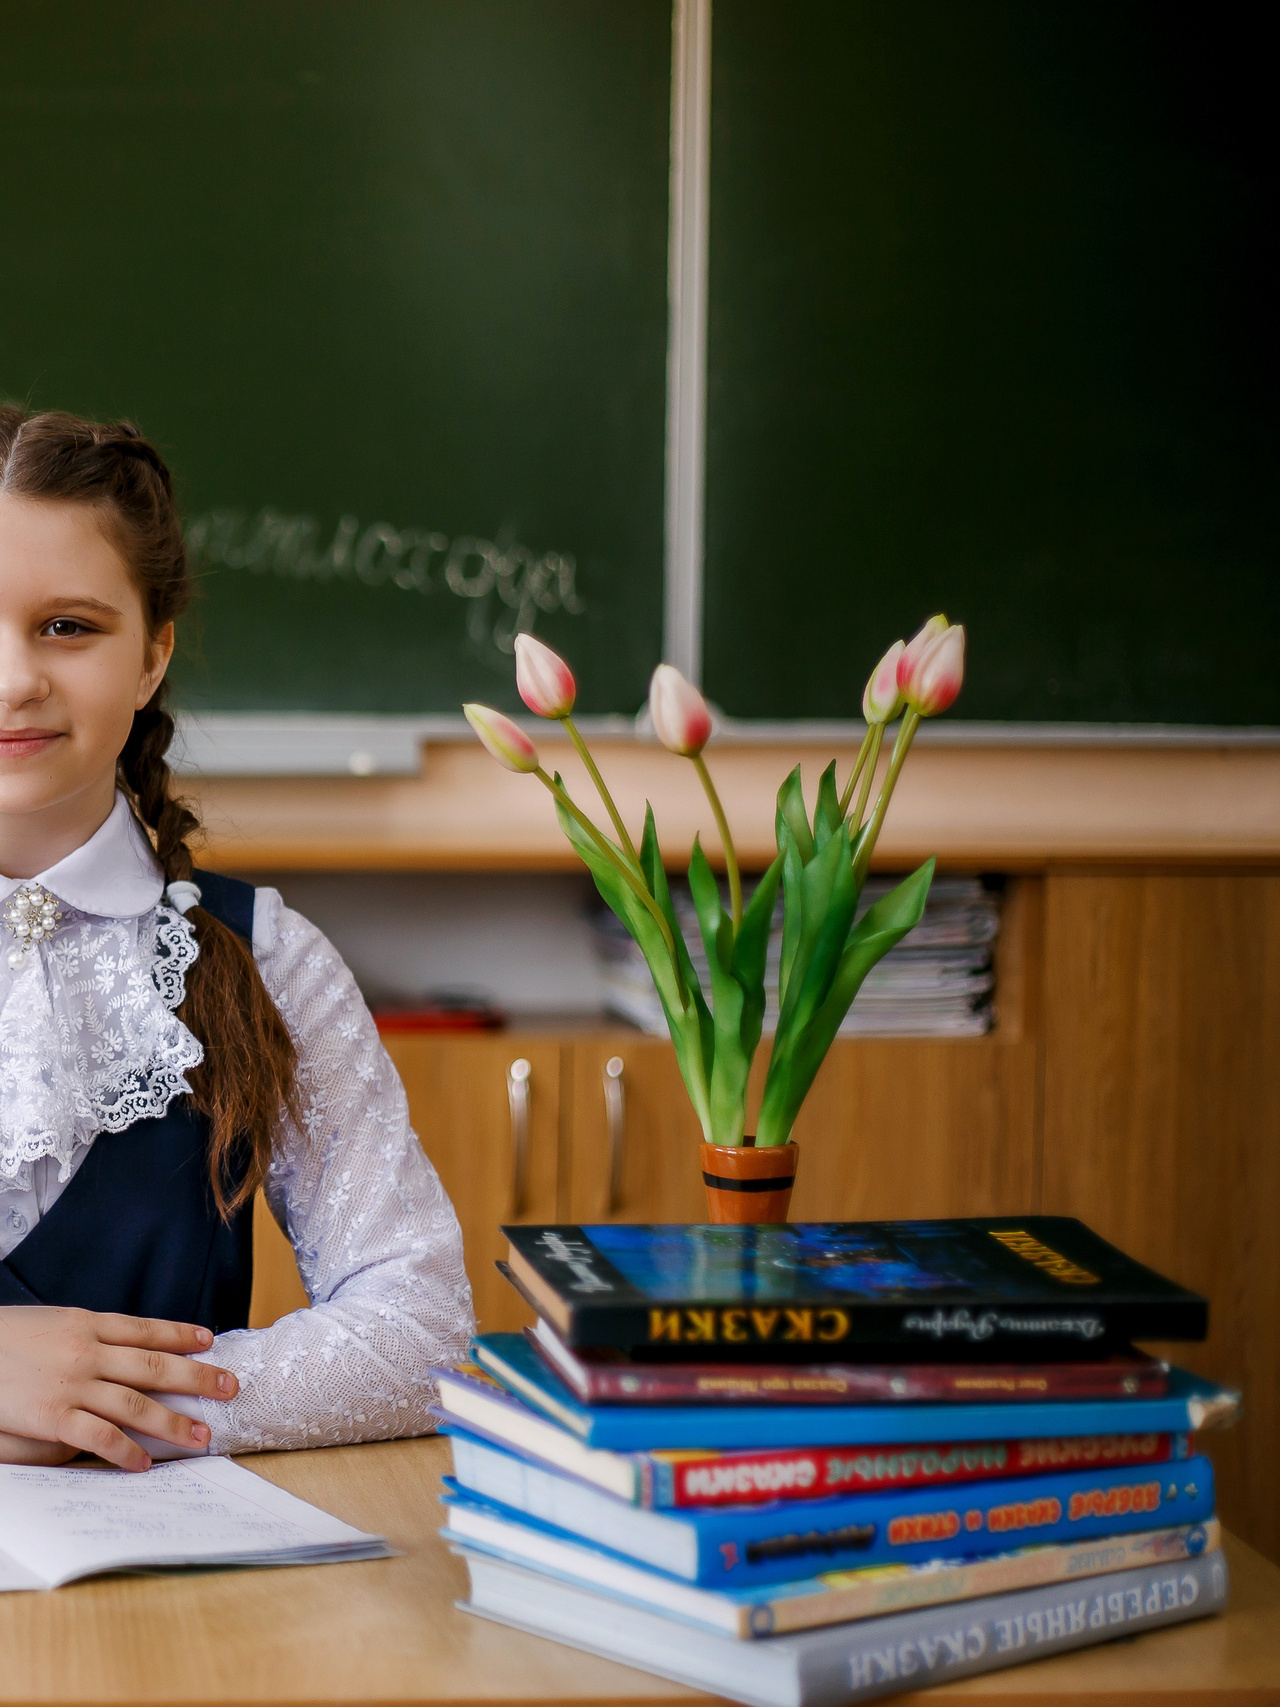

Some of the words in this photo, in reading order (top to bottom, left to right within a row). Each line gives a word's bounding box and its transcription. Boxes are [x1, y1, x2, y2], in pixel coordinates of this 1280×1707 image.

[648, 1307, 851, 1342] СКАЗКИ
[826, 1442, 1009, 1485] НАРОДНЫЕ
[1020, 1433, 1159, 1467] РУССКИЕ
[684, 1458, 817, 1498] СКАЗКИ
[987, 1497, 1062, 1533] СКАЗКИ
[1068, 1481, 1162, 1521] ДОБРЫЕ
[887, 1510, 960, 1546] СТИХИ
[996, 1573, 1201, 1654] СЕРЕБРЯНЫЕ
[847, 1626, 988, 1690] СКАЗКИ
